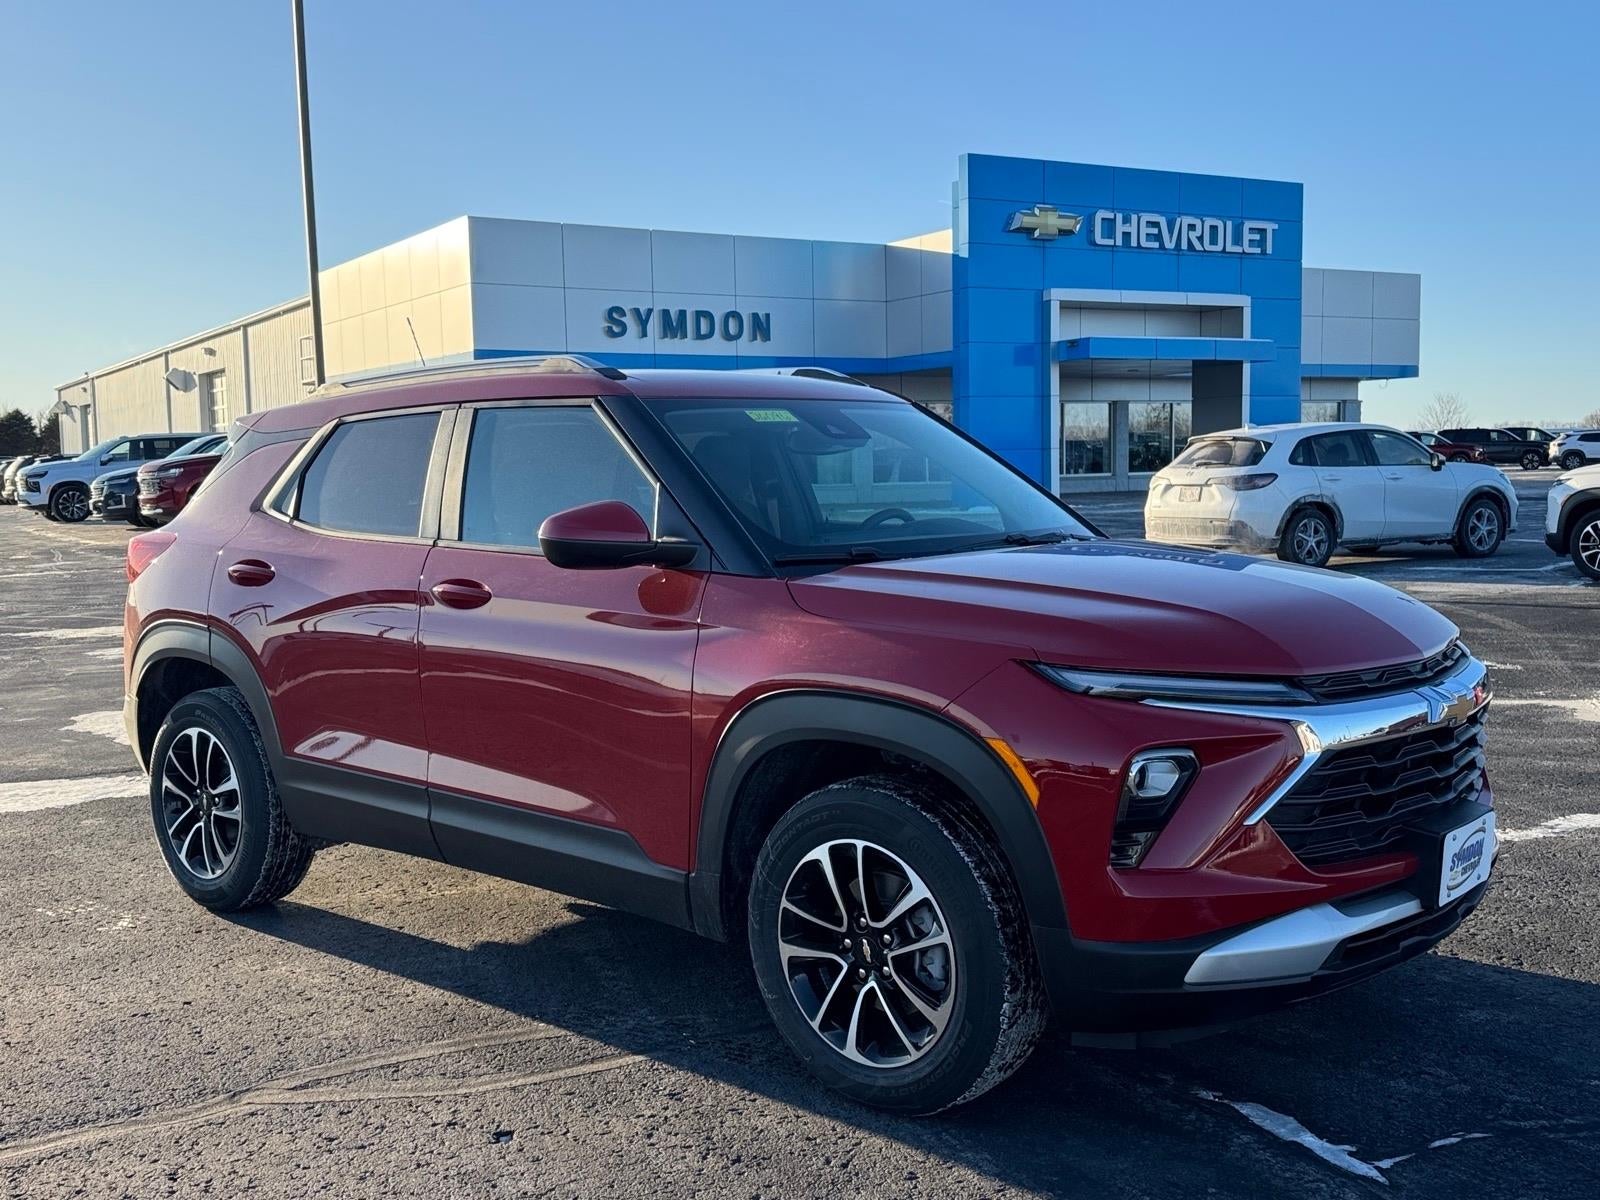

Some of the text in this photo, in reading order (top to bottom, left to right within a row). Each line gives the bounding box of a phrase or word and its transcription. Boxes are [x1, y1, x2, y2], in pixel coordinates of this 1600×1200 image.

[1094, 209, 1279, 255] CHEVROLET
[604, 305, 772, 343] SYMDON
[1450, 837, 1484, 873] SYMDON
